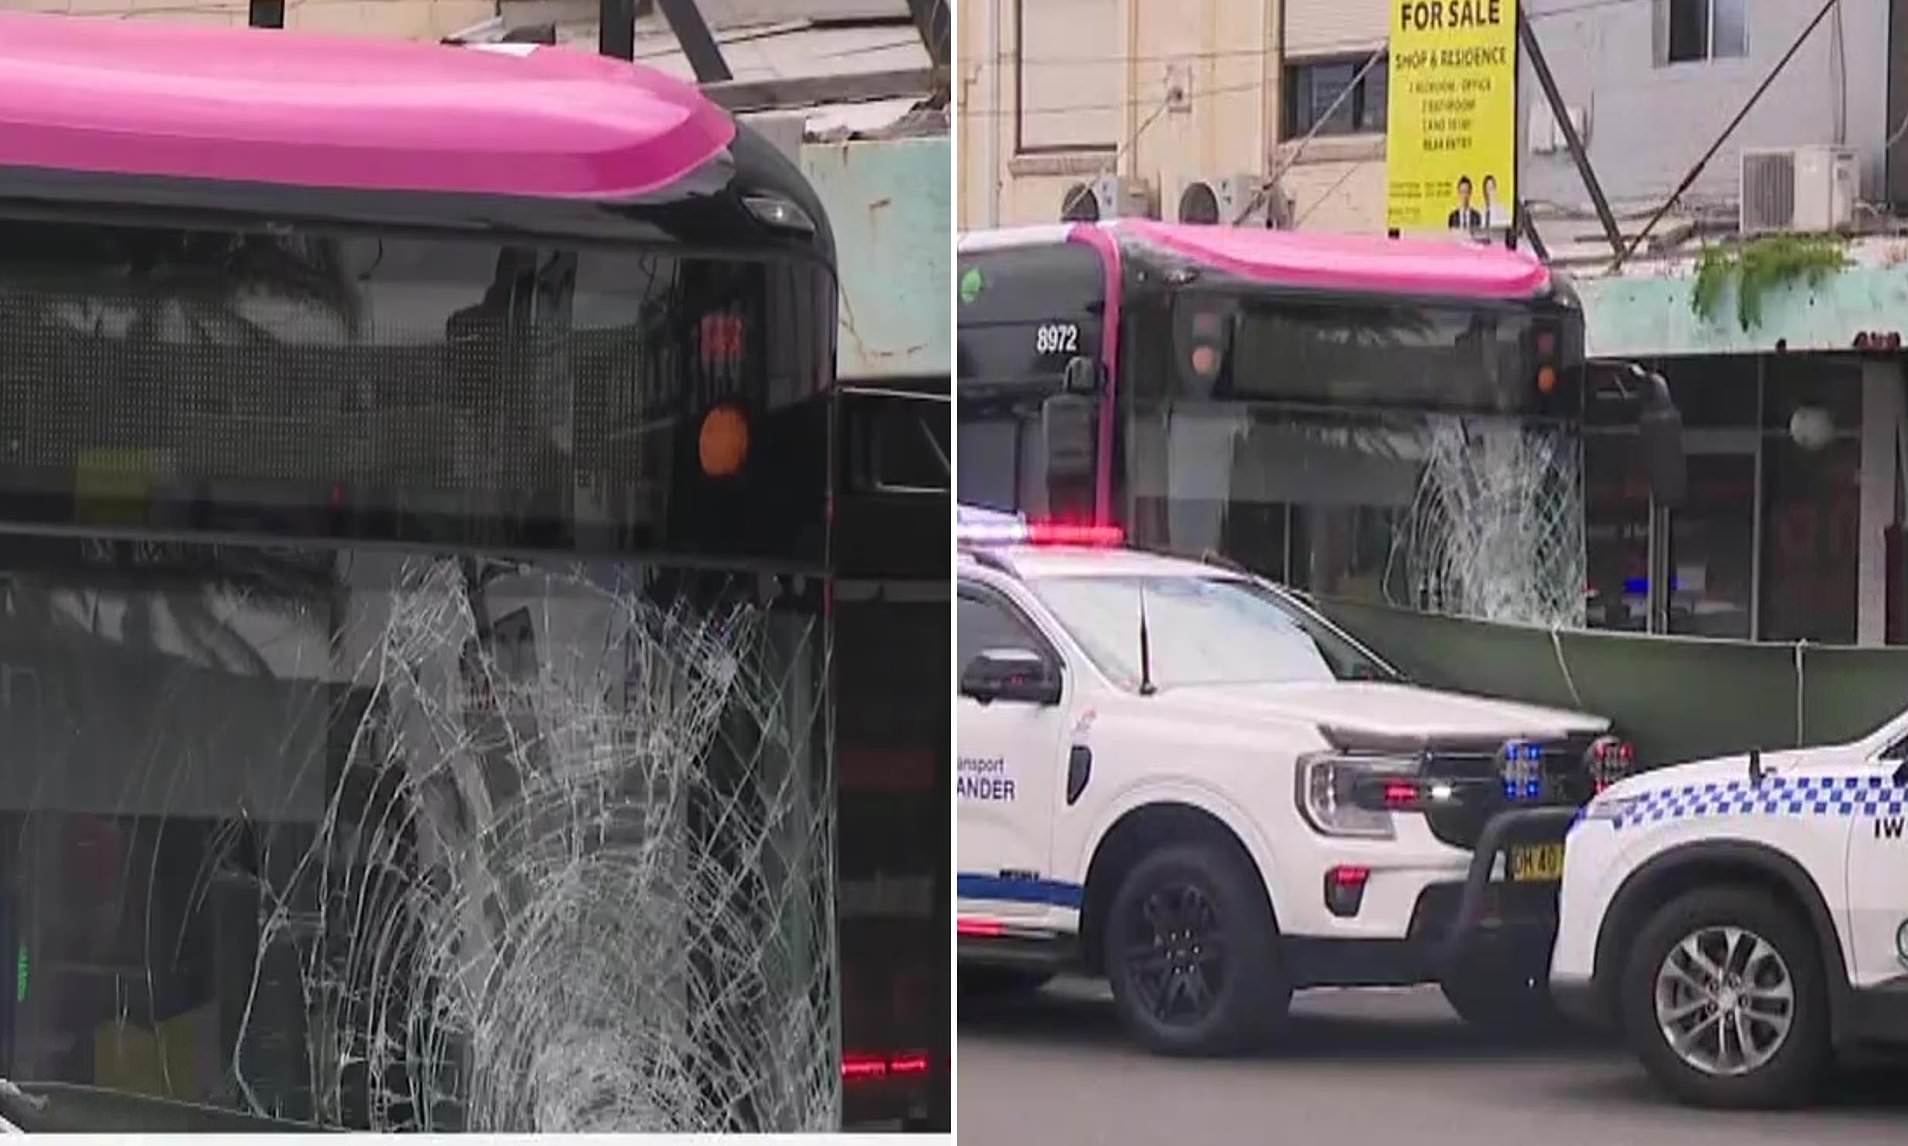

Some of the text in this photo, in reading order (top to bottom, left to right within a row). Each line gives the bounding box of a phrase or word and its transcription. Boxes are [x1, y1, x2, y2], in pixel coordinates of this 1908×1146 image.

[1401, 0, 1500, 31] FOR SALE
[1396, 50, 1427, 69] SHOP
[1440, 46, 1506, 66] RESIDENCE
[1037, 324, 1077, 354] 8972
[957, 776, 1015, 801] ANDER
